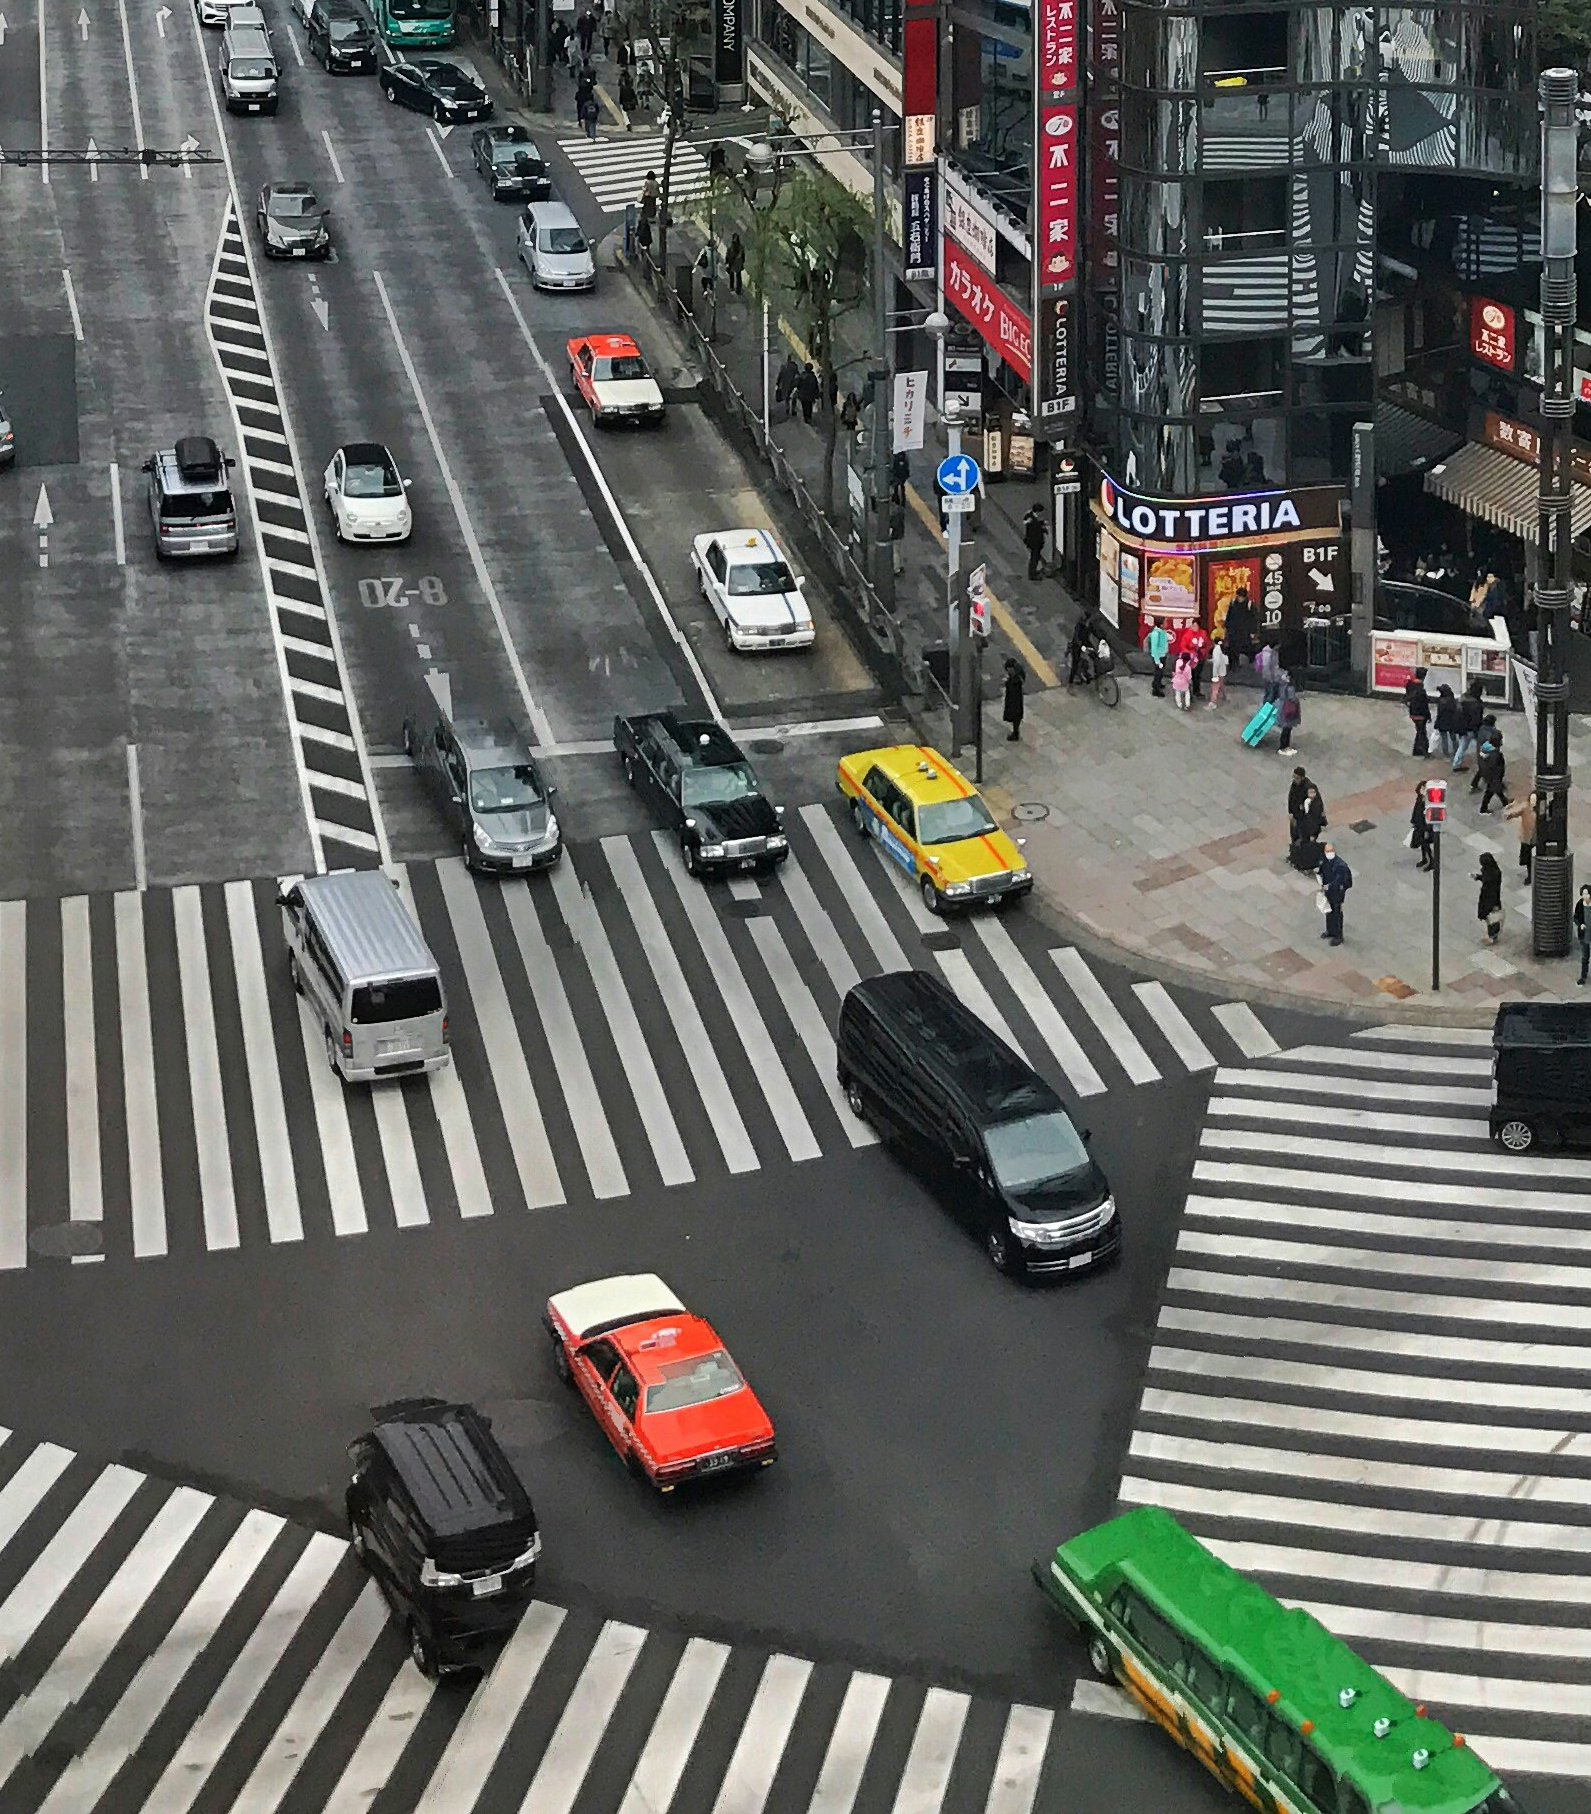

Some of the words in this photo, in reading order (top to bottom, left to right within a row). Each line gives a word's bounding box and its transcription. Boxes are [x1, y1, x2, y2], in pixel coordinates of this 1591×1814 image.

[1045, 5, 1057, 67] レストラン
[1057, 2, 1074, 65] 不二家
[1048, 144, 1069, 243] 不二家
[949, 260, 995, 323] カラオケ
[1055, 317, 1068, 396] LOTTERIA
[1475, 340, 1512, 364] レストラン
[1046, 396, 1071, 414] B1F
[1117, 499, 1300, 540] LOTTERIA
[1303, 546, 1339, 564] B1F
[1265, 569, 1284, 585] 45
[1266, 609, 1282, 625] 10
